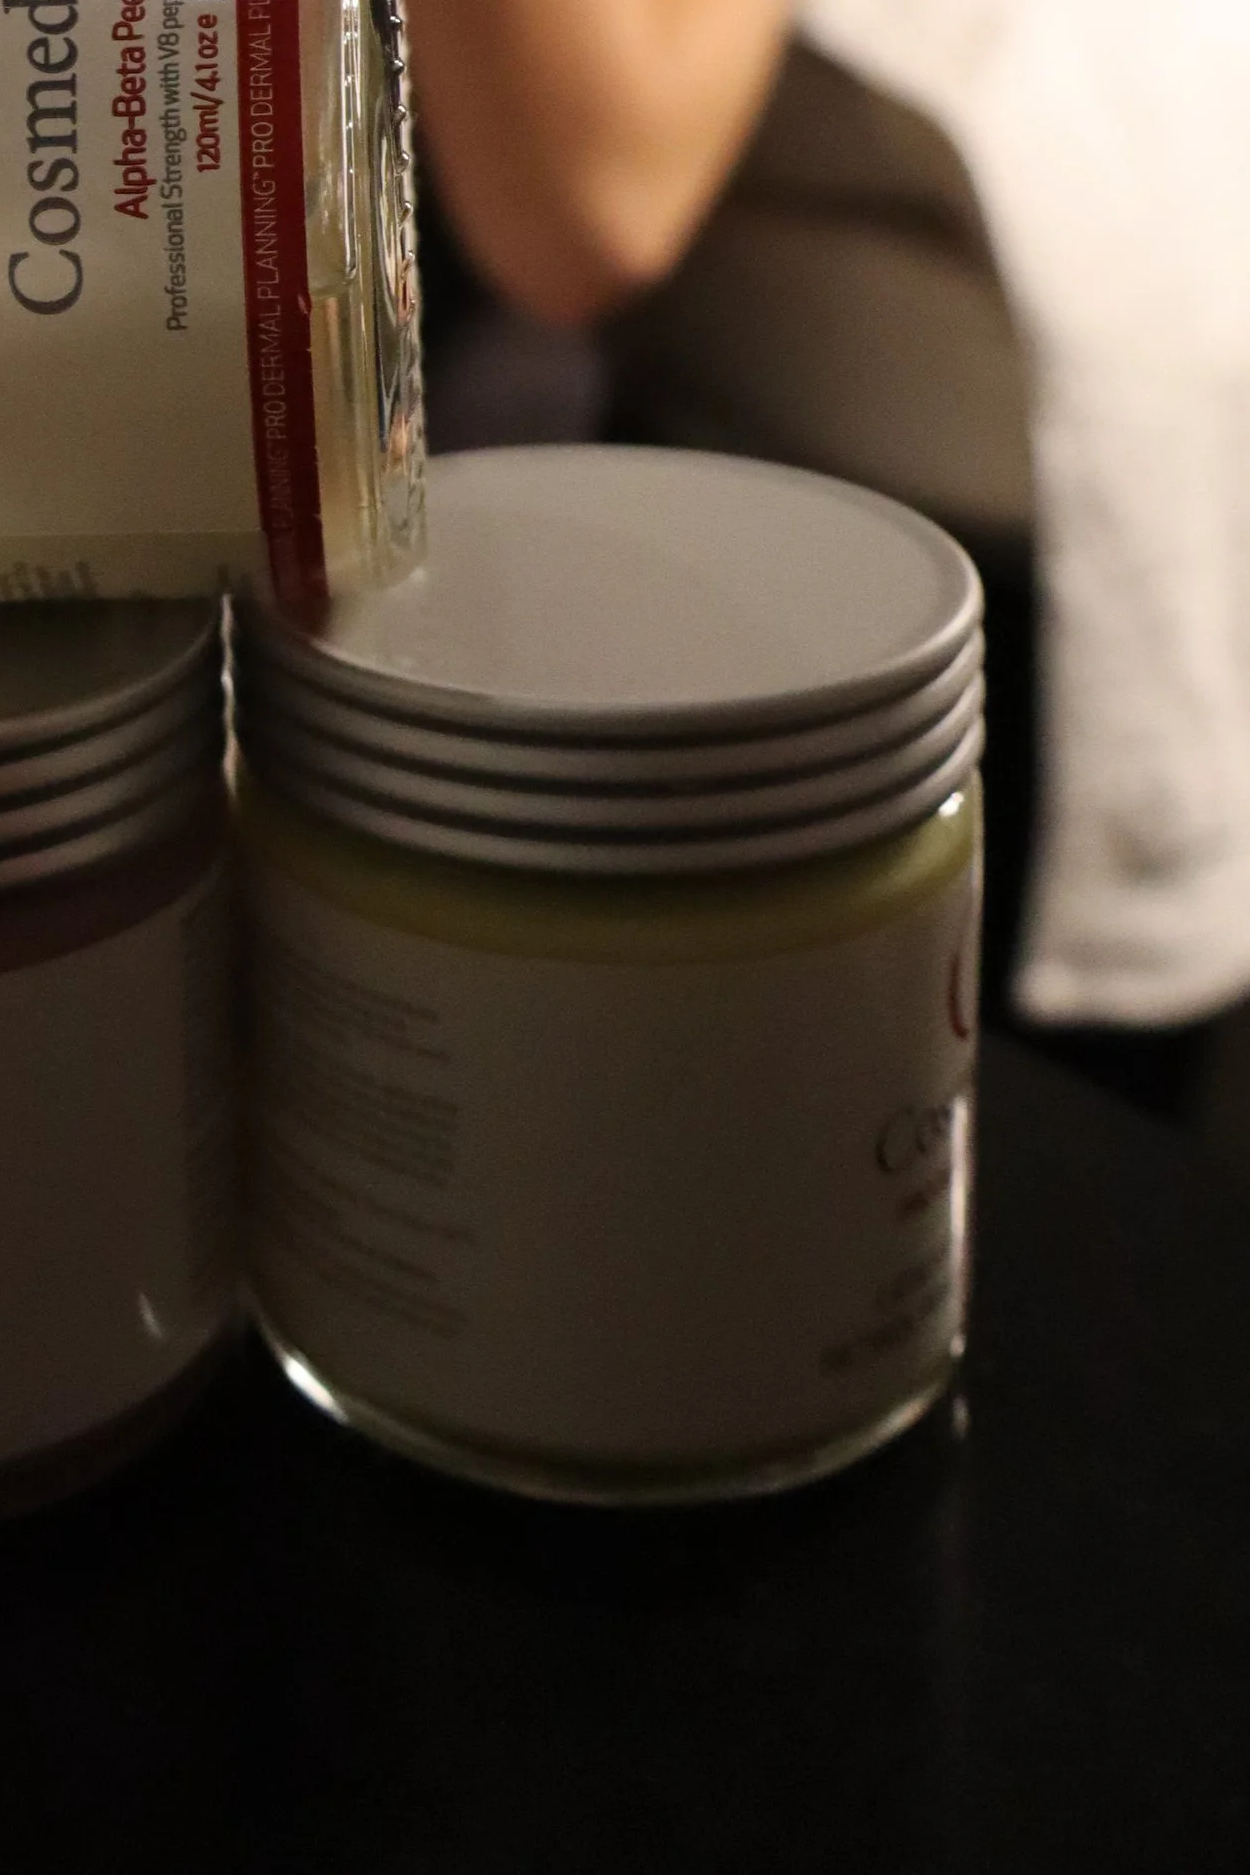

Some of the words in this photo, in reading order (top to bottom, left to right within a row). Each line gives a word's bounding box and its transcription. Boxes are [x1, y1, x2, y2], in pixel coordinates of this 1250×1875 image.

[158, 63, 181, 106] with
[159, 33, 180, 59] V8
[249, 24, 273, 116] DERMAL
[112, 47, 156, 219] Alpha-Beta
[159, 109, 187, 199] Strength
[252, 122, 274, 167] PRO
[161, 203, 188, 331] Professional
[256, 305, 286, 395] DERMAL
[262, 401, 286, 439] PRO
